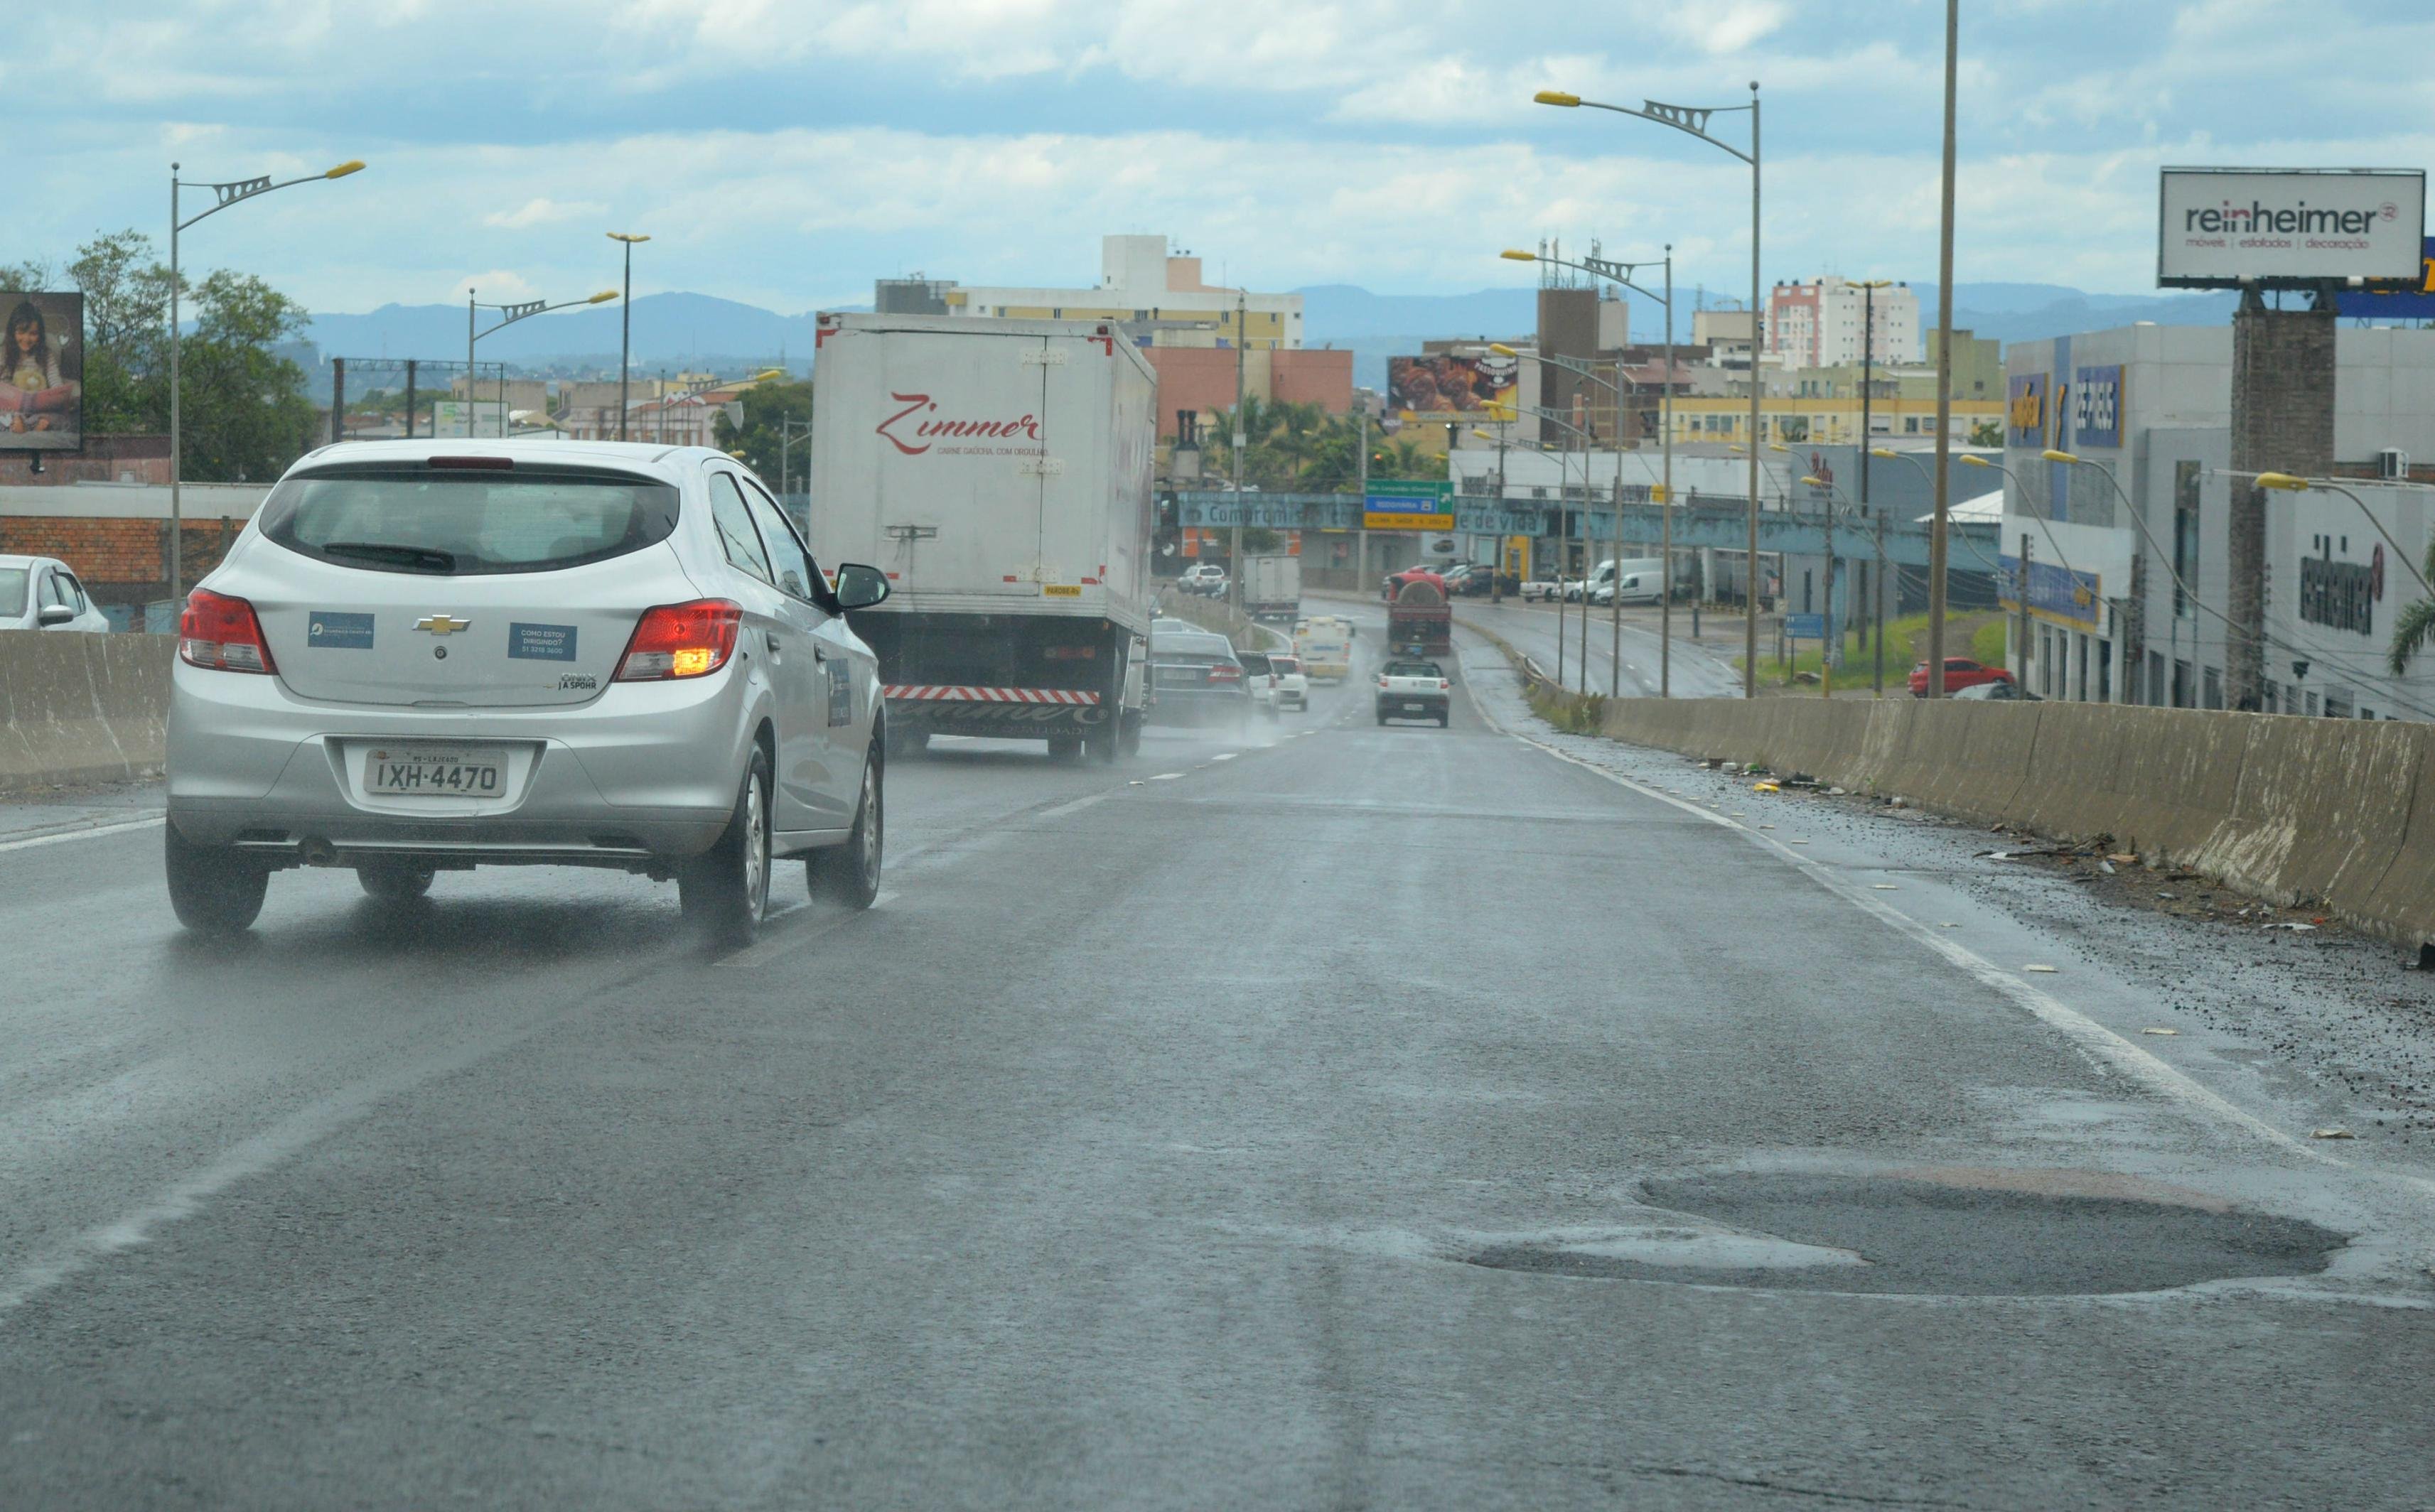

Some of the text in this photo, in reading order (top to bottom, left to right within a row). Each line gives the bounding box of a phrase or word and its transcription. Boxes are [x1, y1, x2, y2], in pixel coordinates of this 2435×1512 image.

[2186, 200, 2377, 234] reinheimer
[2186, 236, 2370, 249] móveis estofados decoração
[876, 392, 1048, 455] Zimmer
[523, 638, 563, 647] DIRIGINDO?
